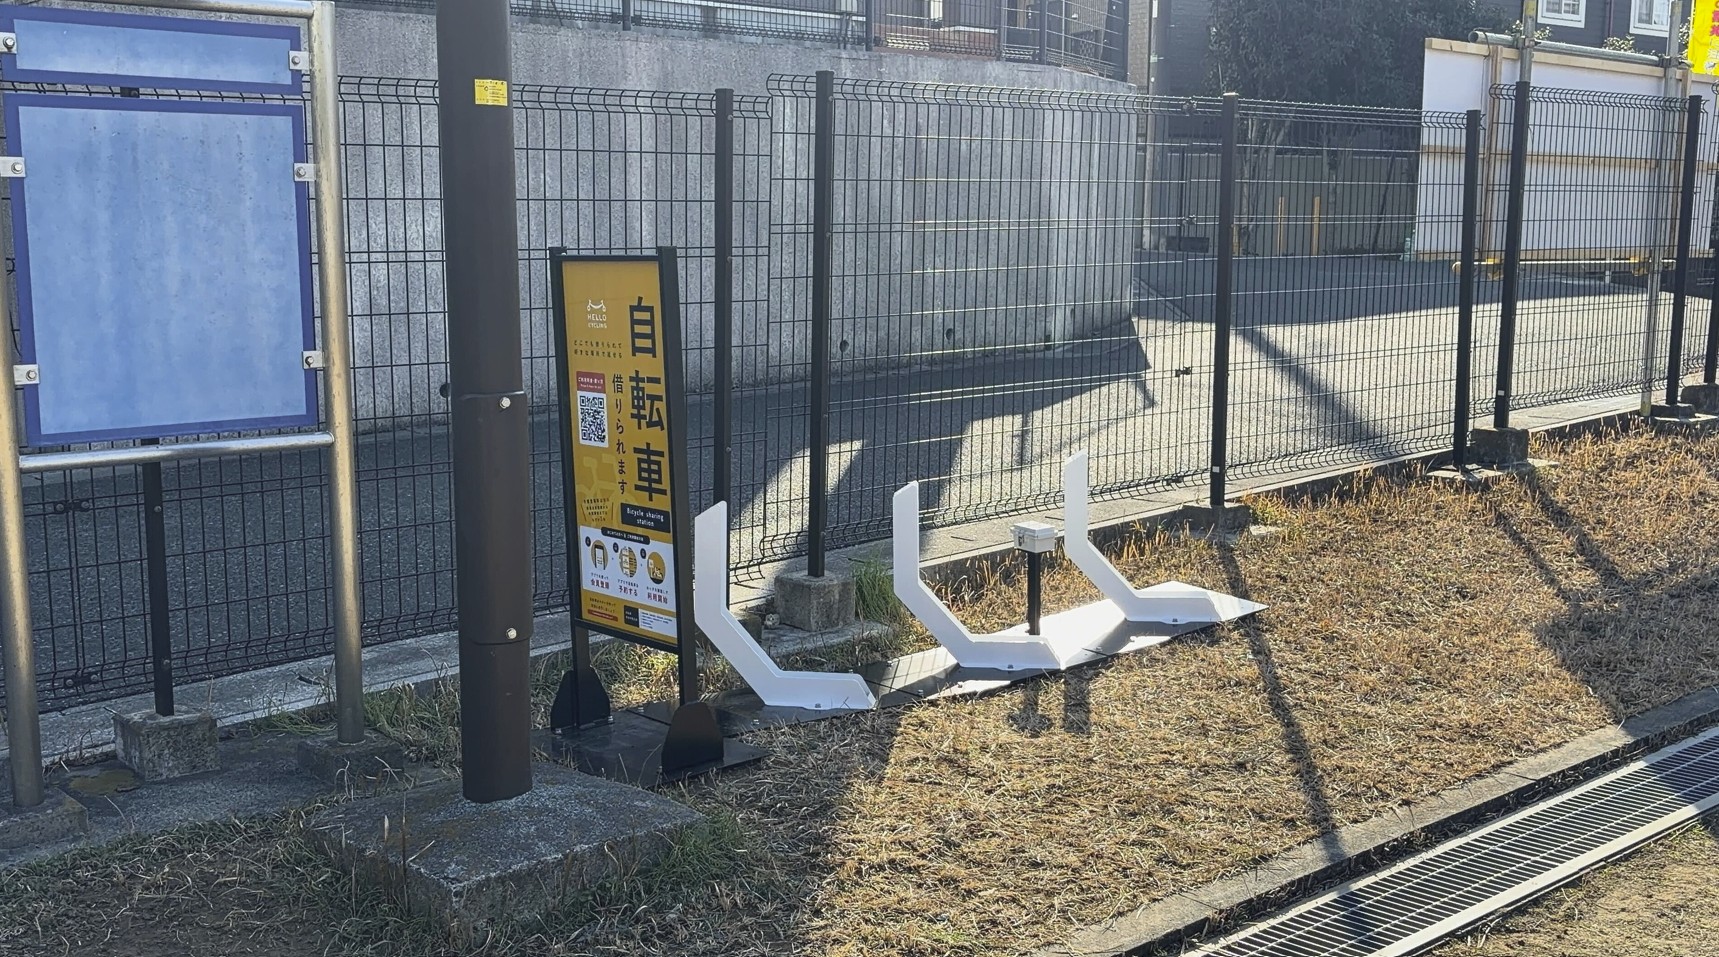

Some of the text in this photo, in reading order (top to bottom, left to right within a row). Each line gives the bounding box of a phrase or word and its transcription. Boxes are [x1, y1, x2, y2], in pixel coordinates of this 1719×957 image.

[587, 313, 607, 321] HELLO
[629, 296, 667, 502] 自転車
[612, 373, 627, 494] 借りられます
[626, 507, 664, 523] Bicycle sharing
[636, 518, 654, 527] station
[618, 585, 638, 597] 予約する
